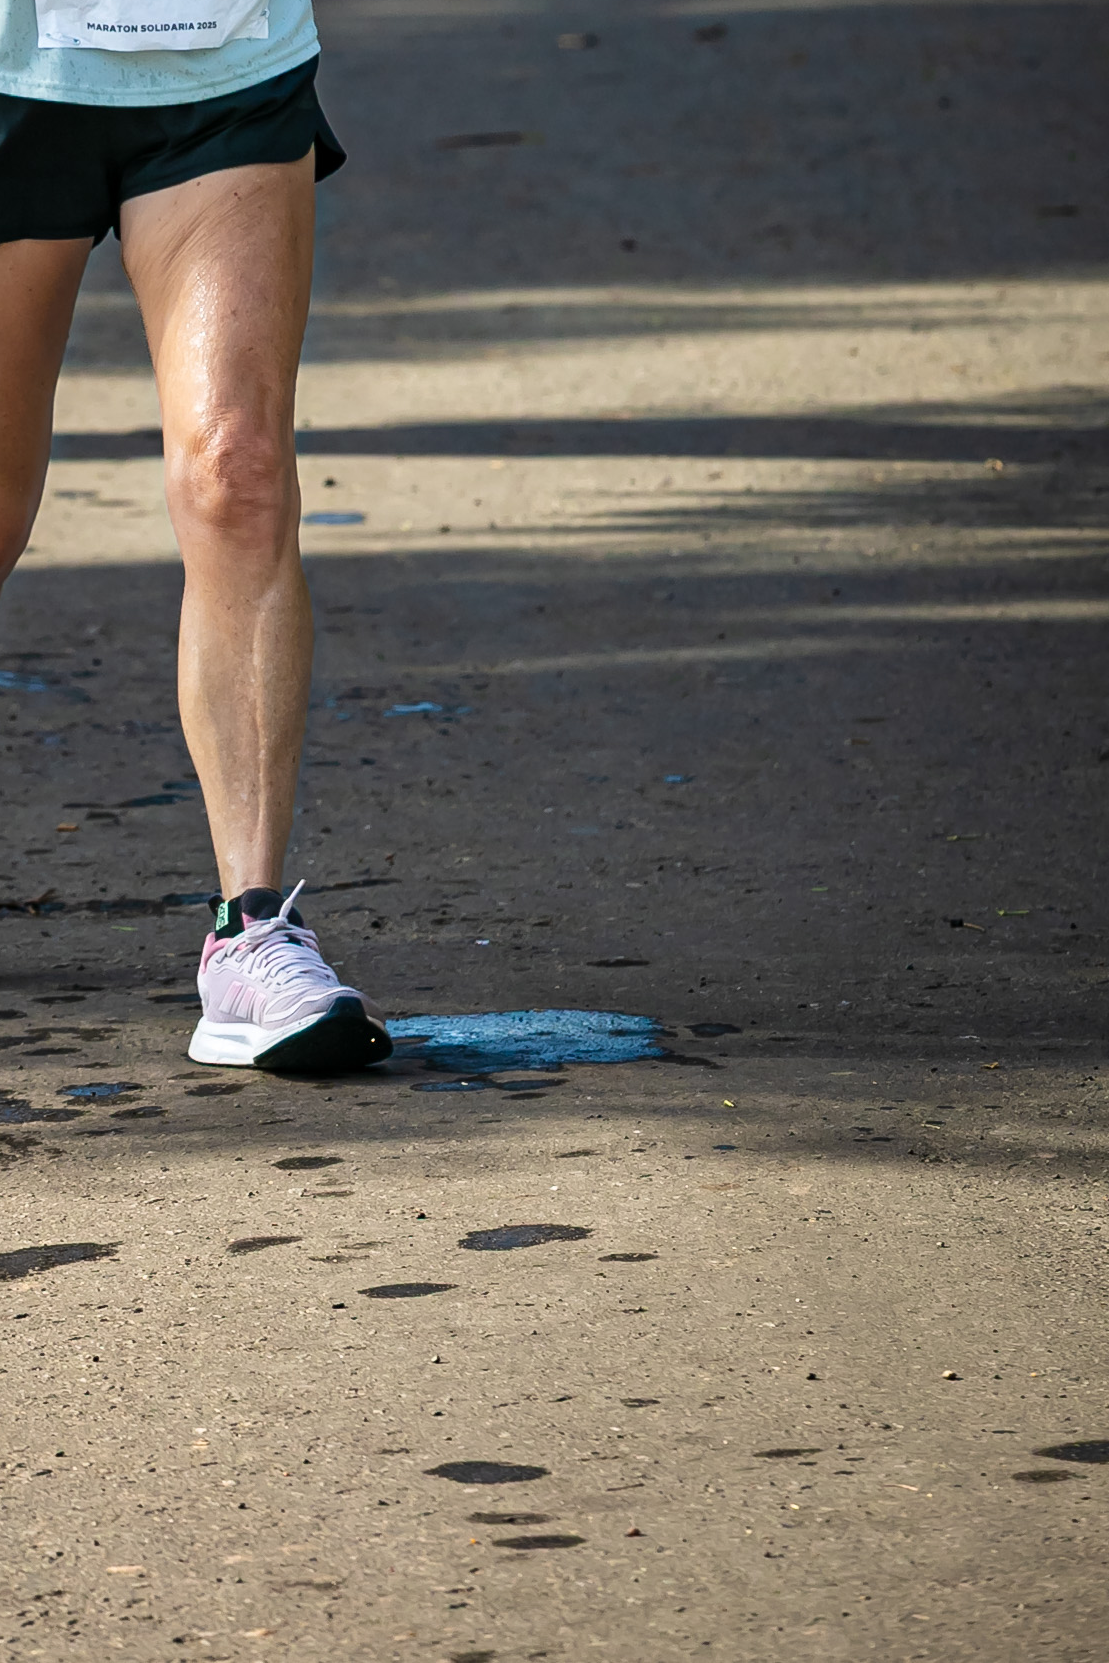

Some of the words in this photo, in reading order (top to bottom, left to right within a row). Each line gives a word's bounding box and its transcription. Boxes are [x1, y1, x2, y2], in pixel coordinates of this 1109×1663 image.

[86, 22, 138, 33] MARATON
[140, 22, 195, 33] SOLIDARIA
[196, 21, 218, 30] 2025
